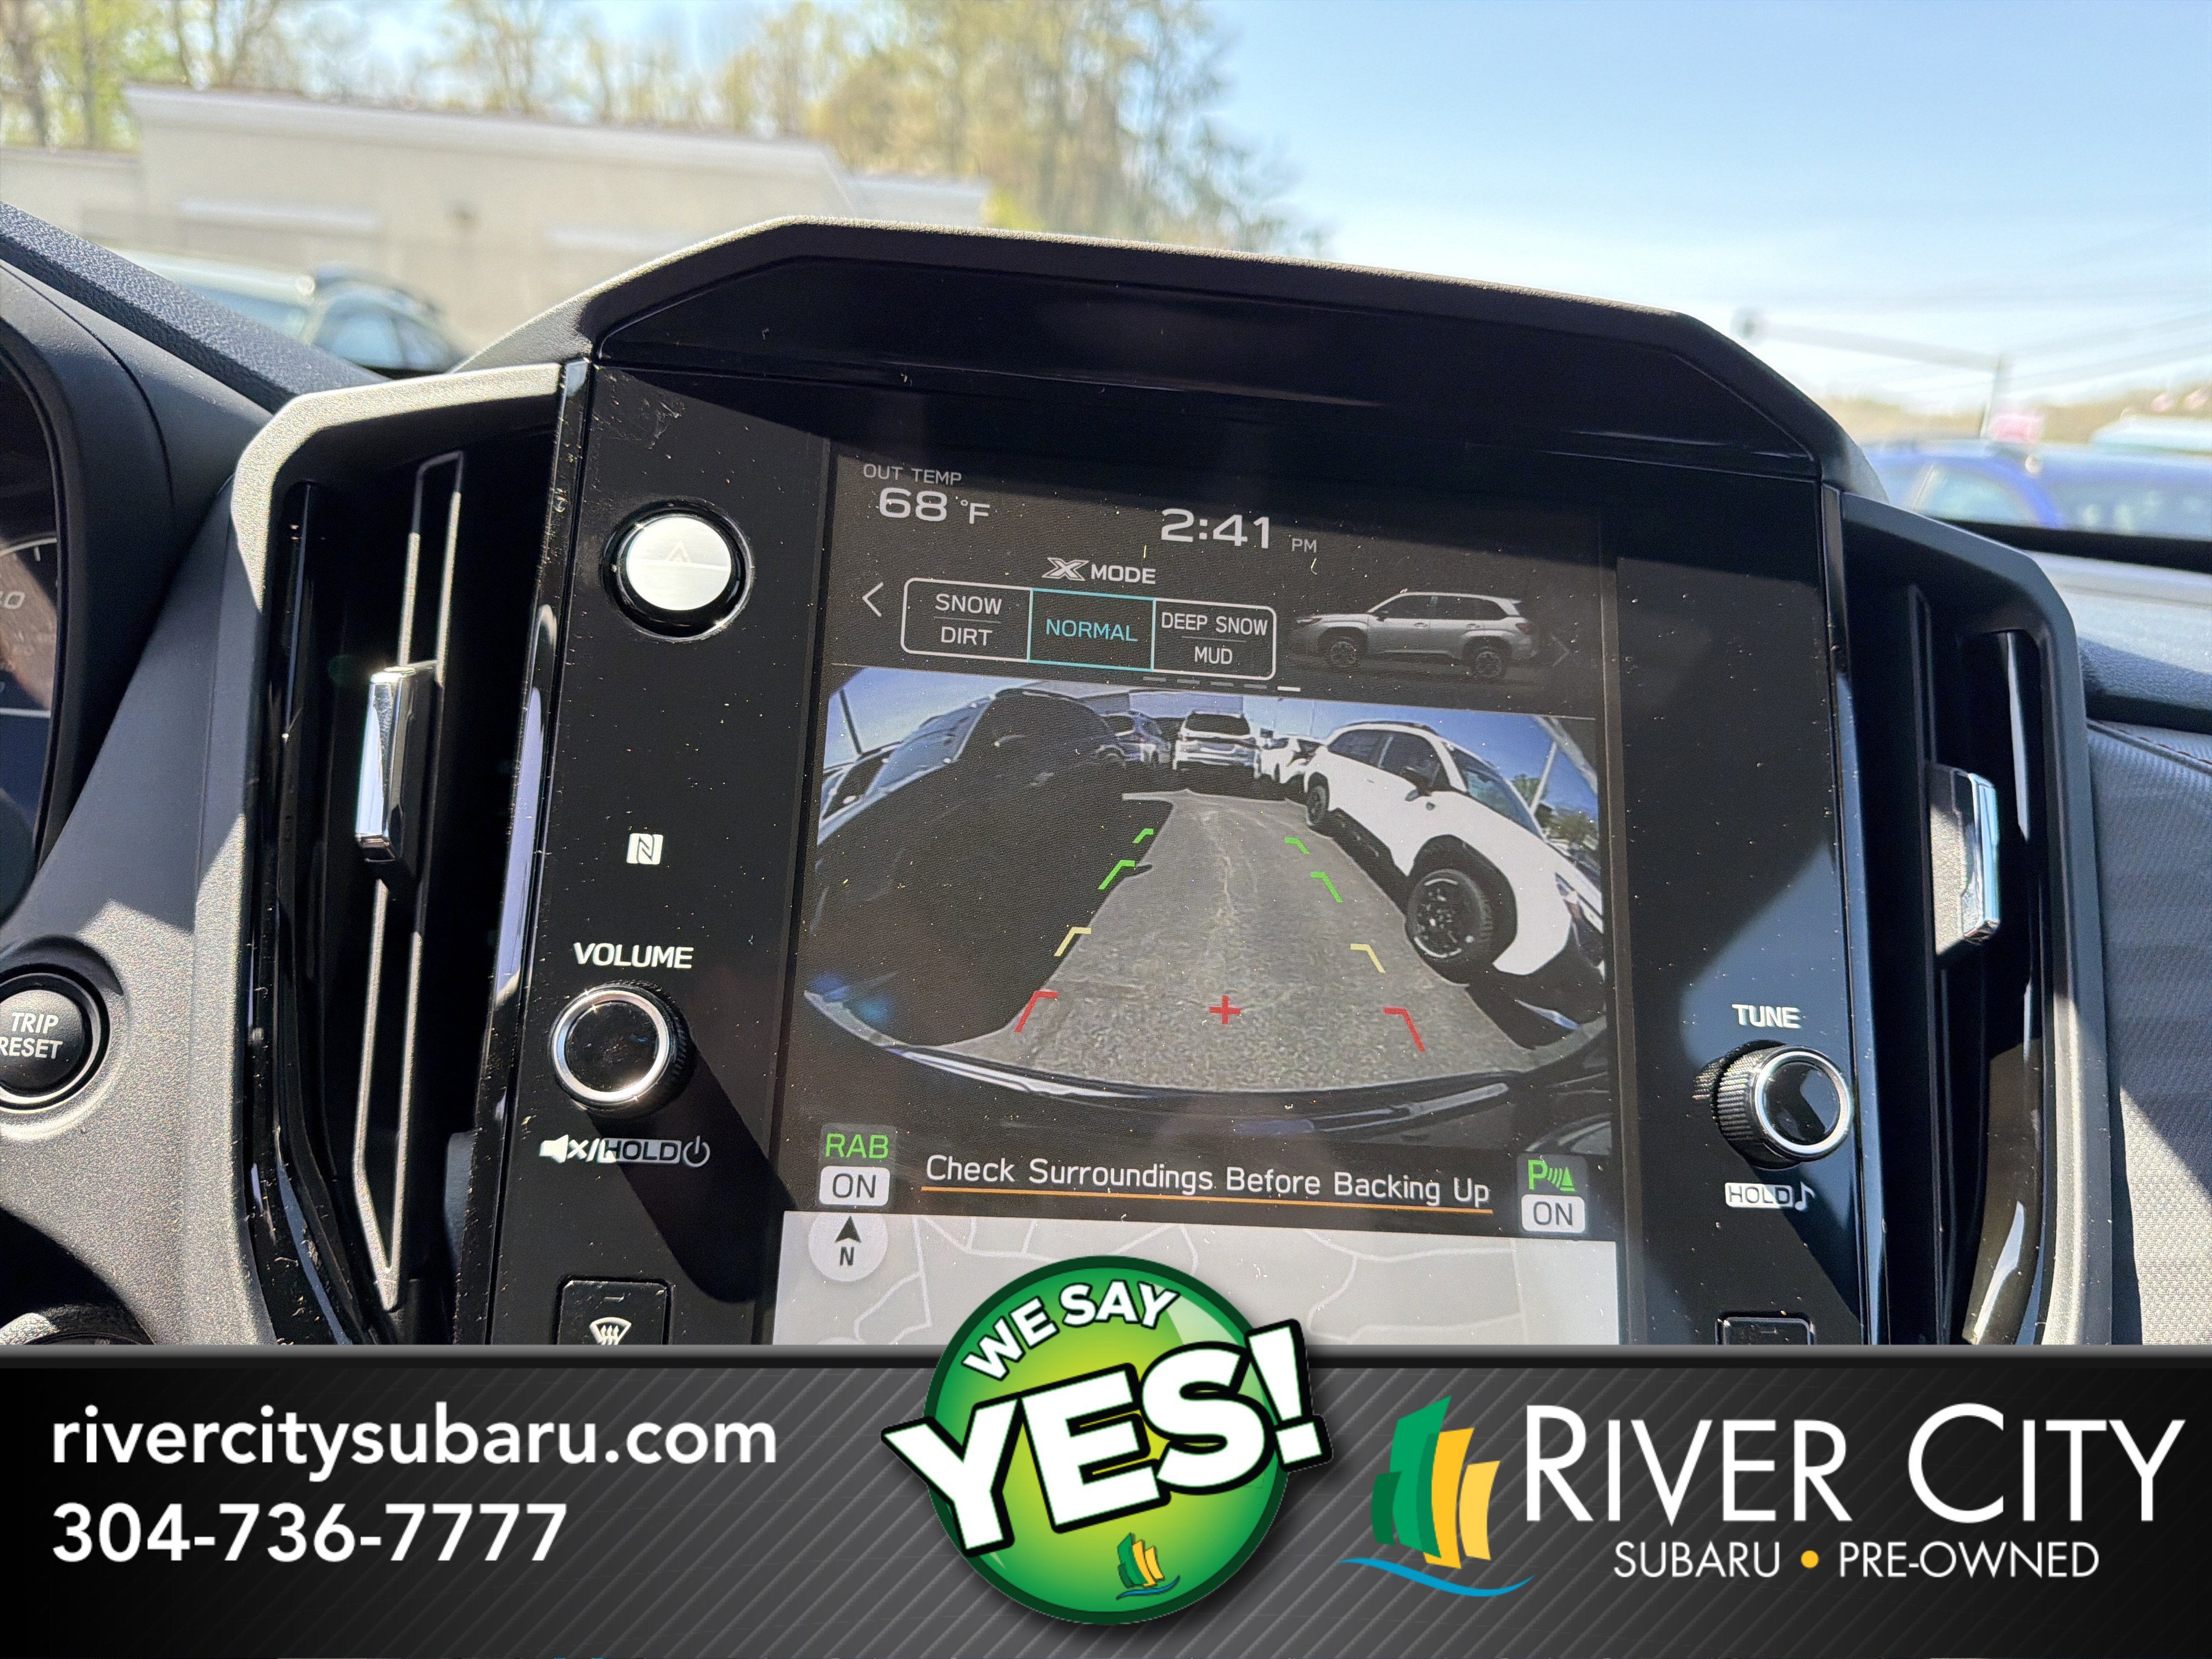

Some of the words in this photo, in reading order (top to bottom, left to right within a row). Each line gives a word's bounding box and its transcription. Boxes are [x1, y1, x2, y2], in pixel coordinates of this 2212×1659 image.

[864, 464, 904, 481] OUT
[911, 467, 961, 486] TEMP
[879, 488, 947, 522] 68
[1161, 508, 1269, 549] 2:41
[1291, 538, 1317, 553] PM
[1091, 563, 1156, 585] MODE
[935, 592, 1002, 616] SNOW
[1046, 619, 1138, 642] NORMAL
[1161, 612, 1207, 631] DEEP
[1215, 617, 1268, 636] SNOW
[940, 627, 993, 647] DIRT
[1194, 646, 1233, 665] MUD
[573, 943, 694, 969] VOLUME
[12, 1012, 59, 1034] TRIP
[1732, 1004, 1801, 1028] TUNE
[0, 1036, 64, 1059] RESET
[825, 1133, 890, 1159] RAB
[832, 1173, 876, 1199] ON
[926, 1154, 1015, 1183] Check
[1029, 1159, 1213, 1195] Surroundings
[1226, 1167, 1321, 1195] Before
[1334, 1171, 1442, 1206] Backing
[1453, 1178, 1490, 1207] Up
[1729, 1185, 1791, 1205] HOLD
[1532, 1201, 1575, 1226] ON
[839, 1246, 854, 1266] N
